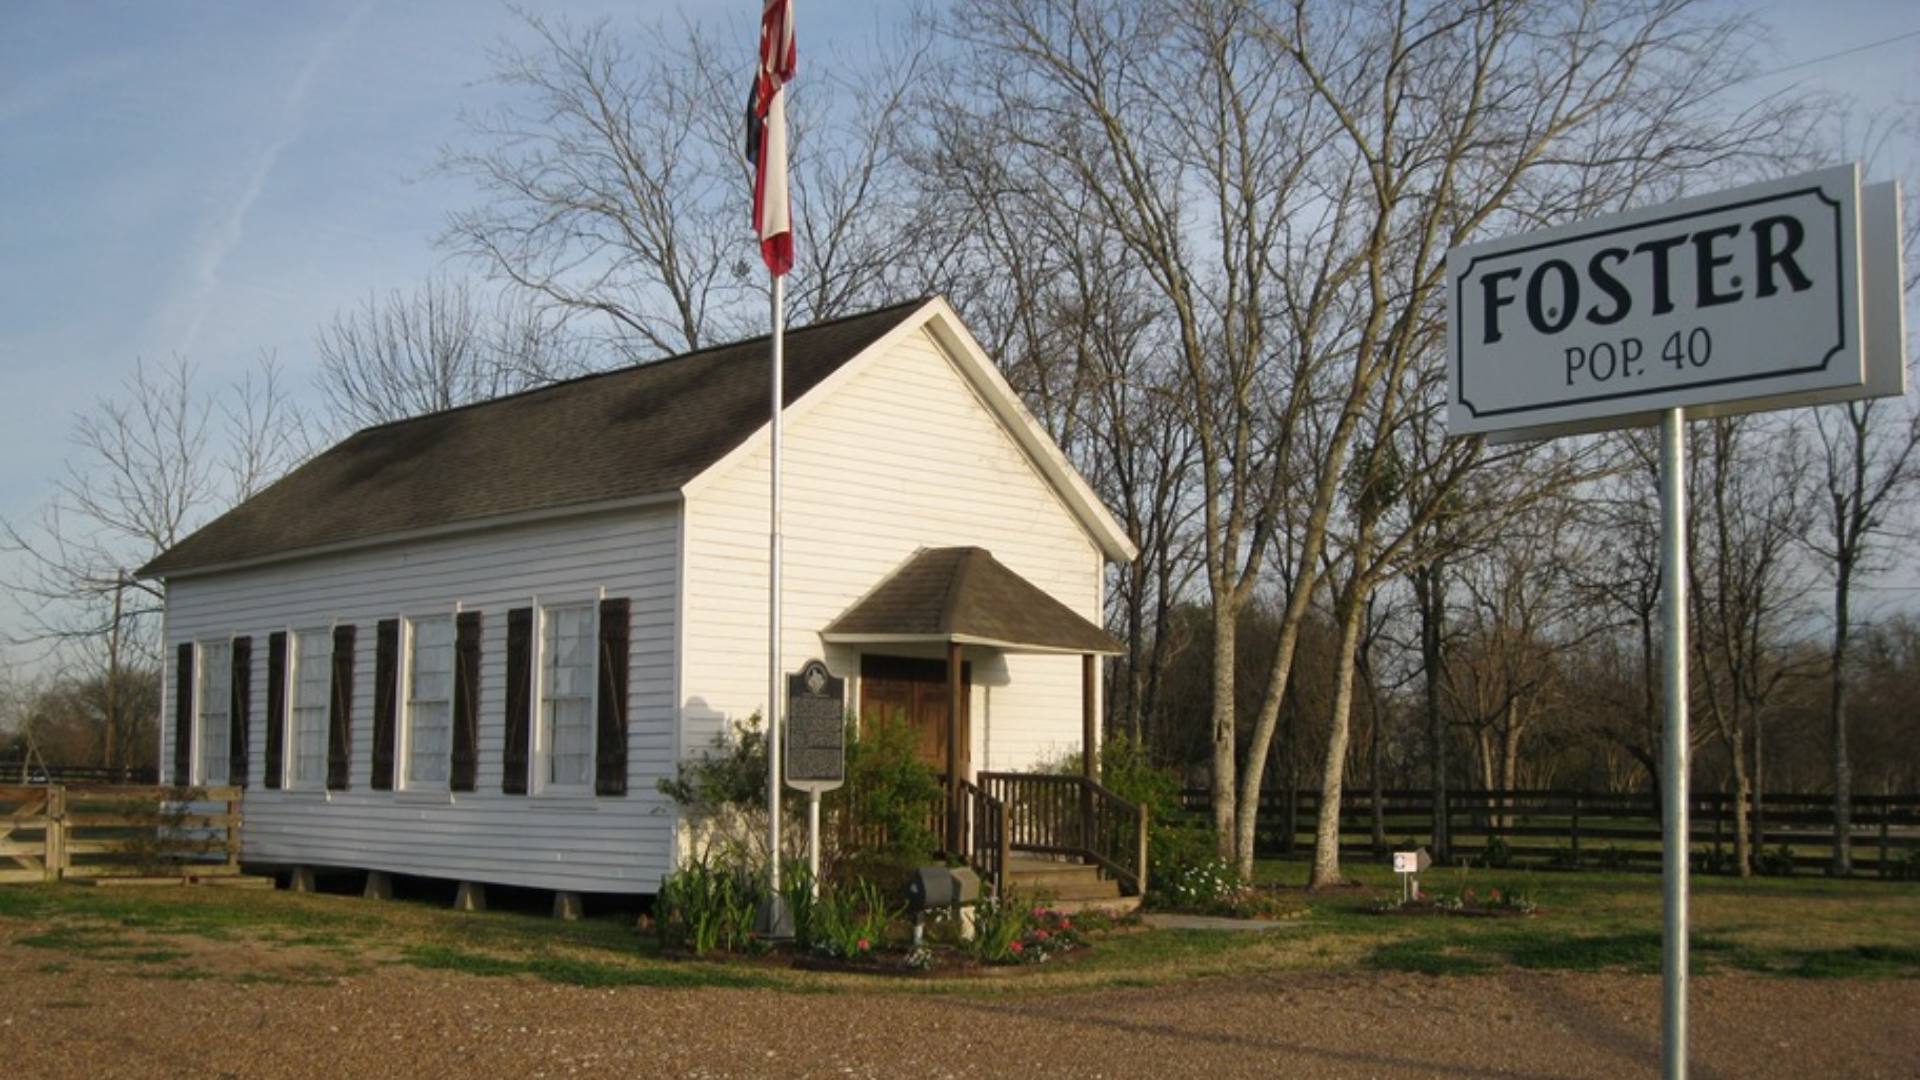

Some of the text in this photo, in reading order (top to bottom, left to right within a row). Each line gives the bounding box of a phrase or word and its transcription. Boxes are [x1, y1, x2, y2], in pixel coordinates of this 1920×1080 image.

[1480, 214, 1813, 345] FOSTER
[1565, 327, 1712, 386] POP. 40
